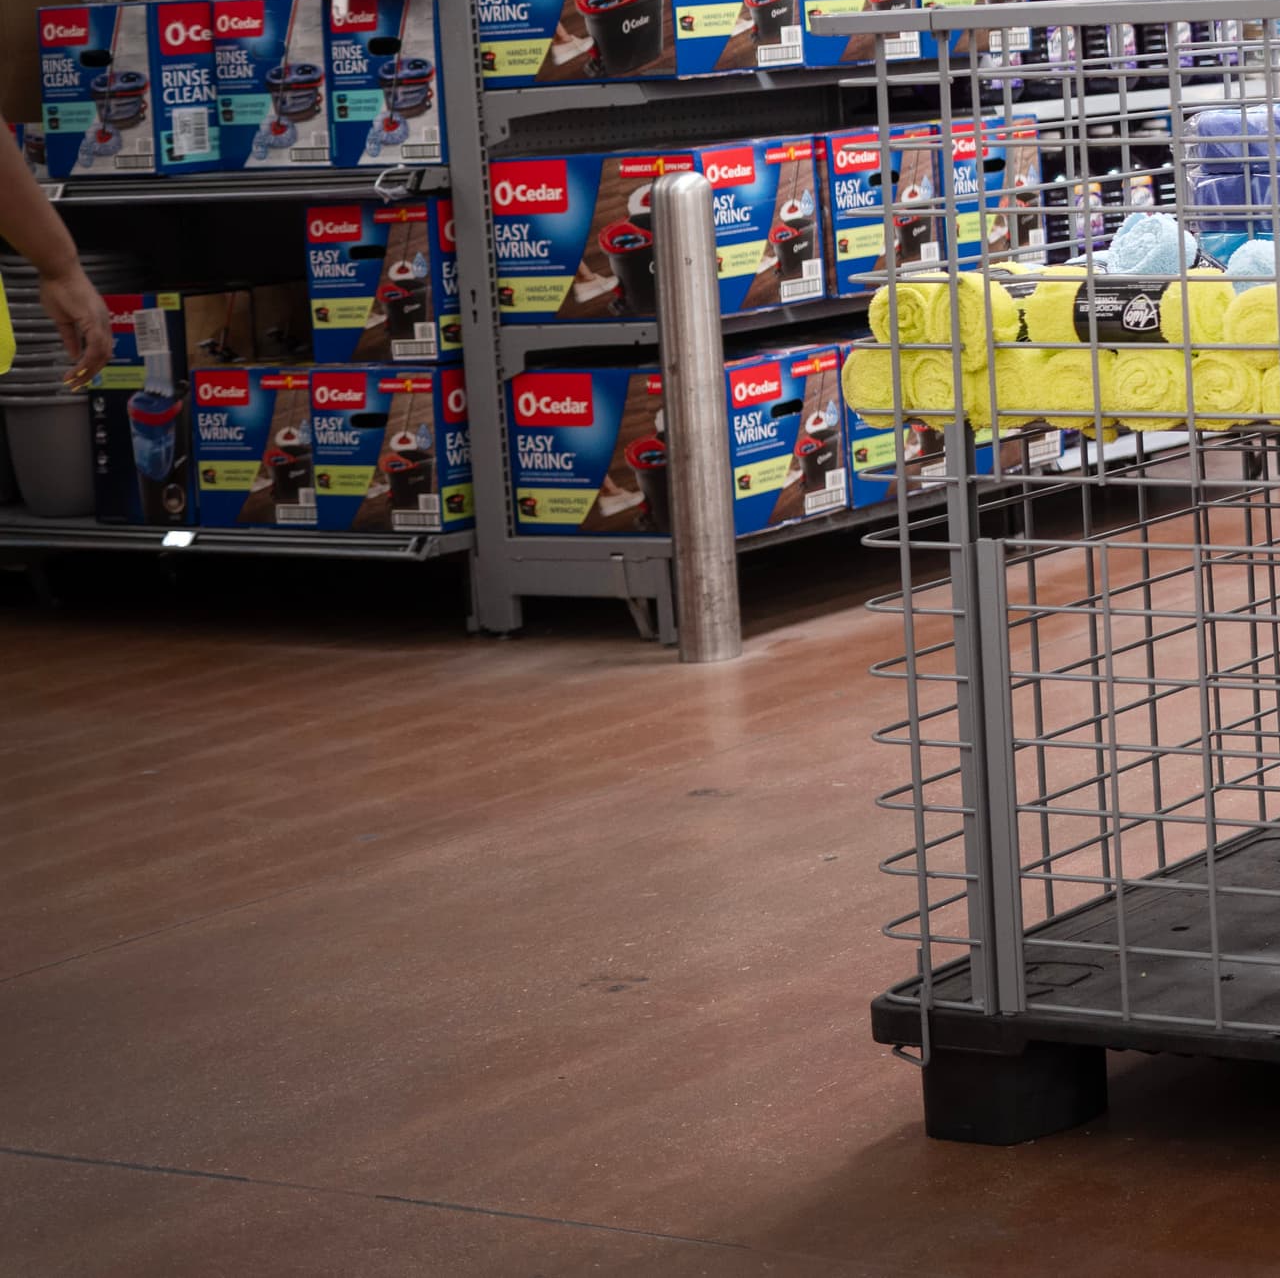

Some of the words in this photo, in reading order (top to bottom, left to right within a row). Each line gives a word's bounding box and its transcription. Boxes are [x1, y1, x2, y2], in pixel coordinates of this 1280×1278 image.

[478, 5, 528, 22] WRING
[622, 15, 649, 34] O-Cedar
[216, 50, 248, 65] RINSE
[332, 46, 364, 60] RINSE
[42, 58, 75, 73] RINSE
[216, 63, 254, 79] CLEAN
[332, 59, 369, 75] CLEAN
[43, 72, 80, 88] CLEAN
[162, 68, 211, 89] RINSE
[162, 85, 216, 105] CLEAN
[706, 163, 752, 183] O-Cedar
[494, 179, 563, 206] O-Cedar
[835, 178, 861, 194] EASY
[836, 190, 875, 209] WRING
[494, 224, 530, 242] EASY
[310, 250, 340, 264] EASY
[496, 240, 549, 258] WRING
[312, 263, 356, 277] WRING
[734, 379, 779, 402] O-Cedar
[518, 391, 588, 417] O-Cedar
[198, 413, 228, 426] EASY
[314, 417, 343, 431] EASY
[733, 411, 762, 430] EASY
[199, 426, 244, 441] WRING
[315, 430, 360, 445] WRING
[735, 425, 777, 445] WRING
[517, 435, 554, 453] EASY
[518, 452, 574, 470] WRING
